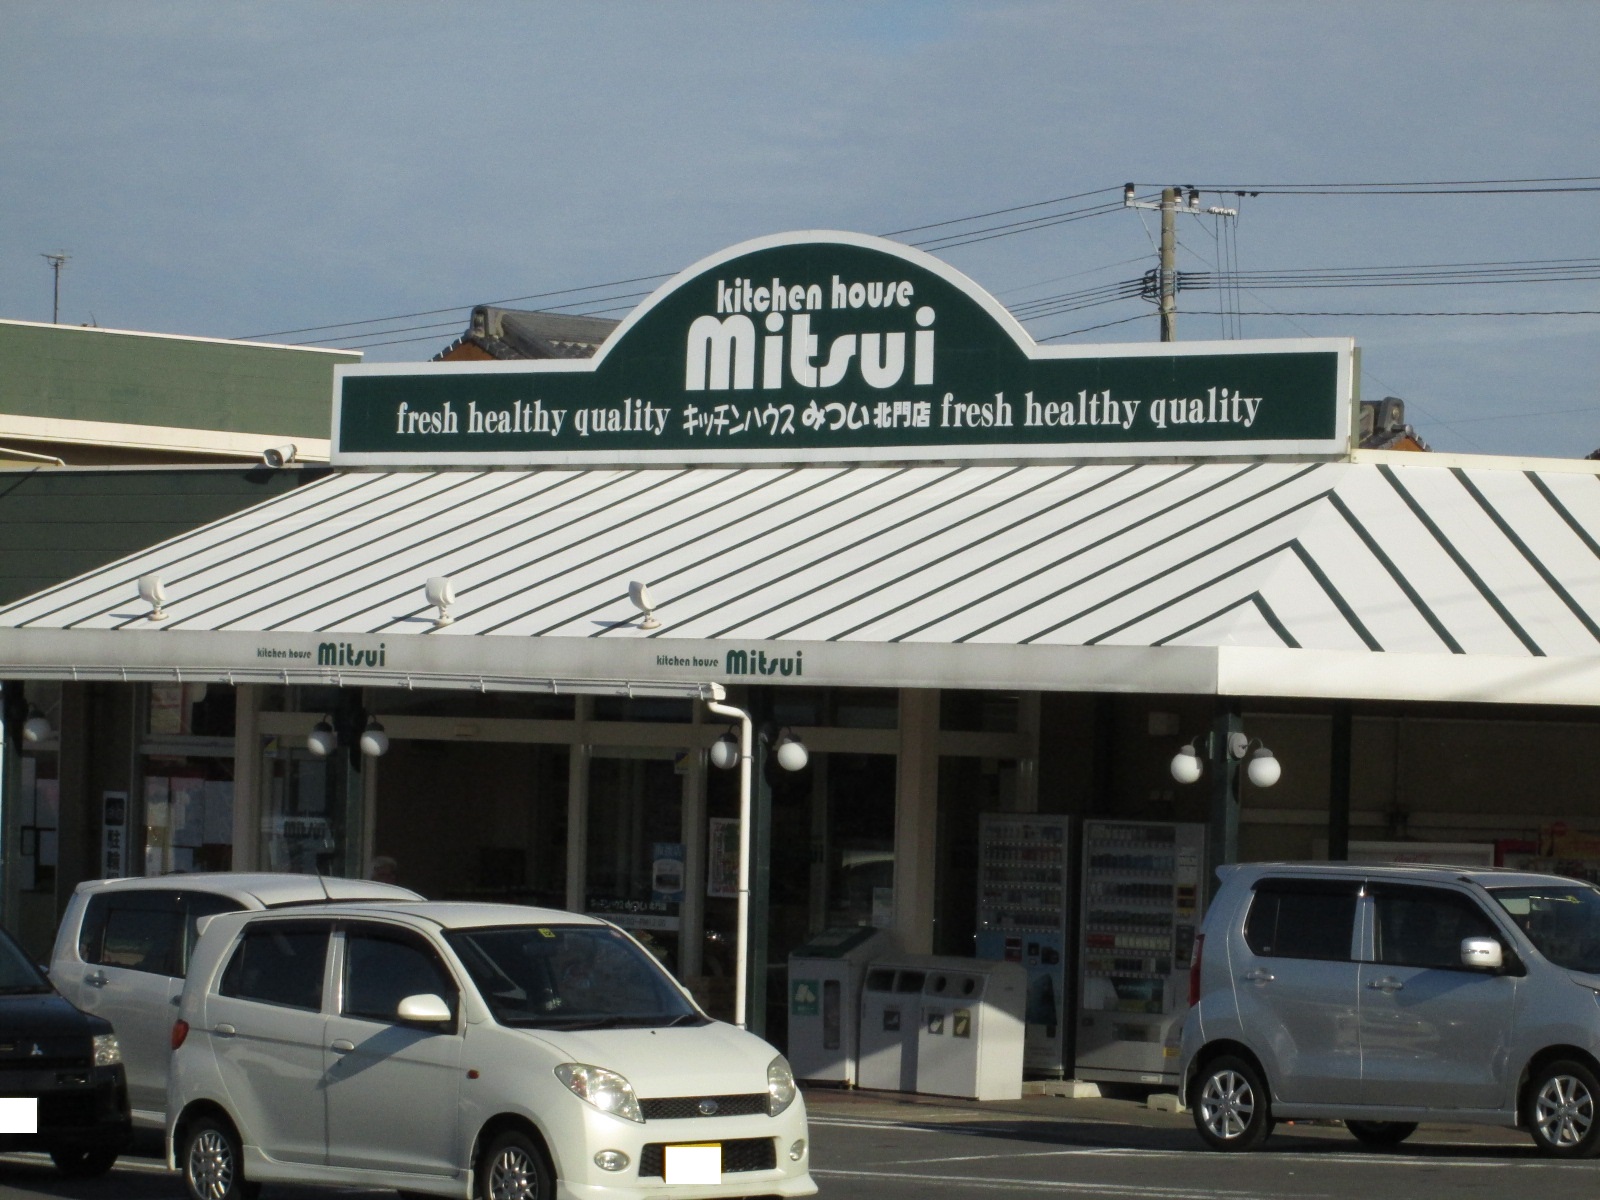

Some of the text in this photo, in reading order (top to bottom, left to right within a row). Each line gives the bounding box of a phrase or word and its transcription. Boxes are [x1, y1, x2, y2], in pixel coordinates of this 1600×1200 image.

[717, 274, 914, 313] kitchen house
[396, 397, 671, 437] fresh healthy quality
[683, 399, 931, 436] キッチンハウス みつい 北門店
[940, 386, 1263, 430] fresh healthy quality
[257, 647, 287, 659] kitchen
[288, 648, 312, 659] house
[656, 654, 690, 667] kitchen
[692, 656, 719, 667] house
